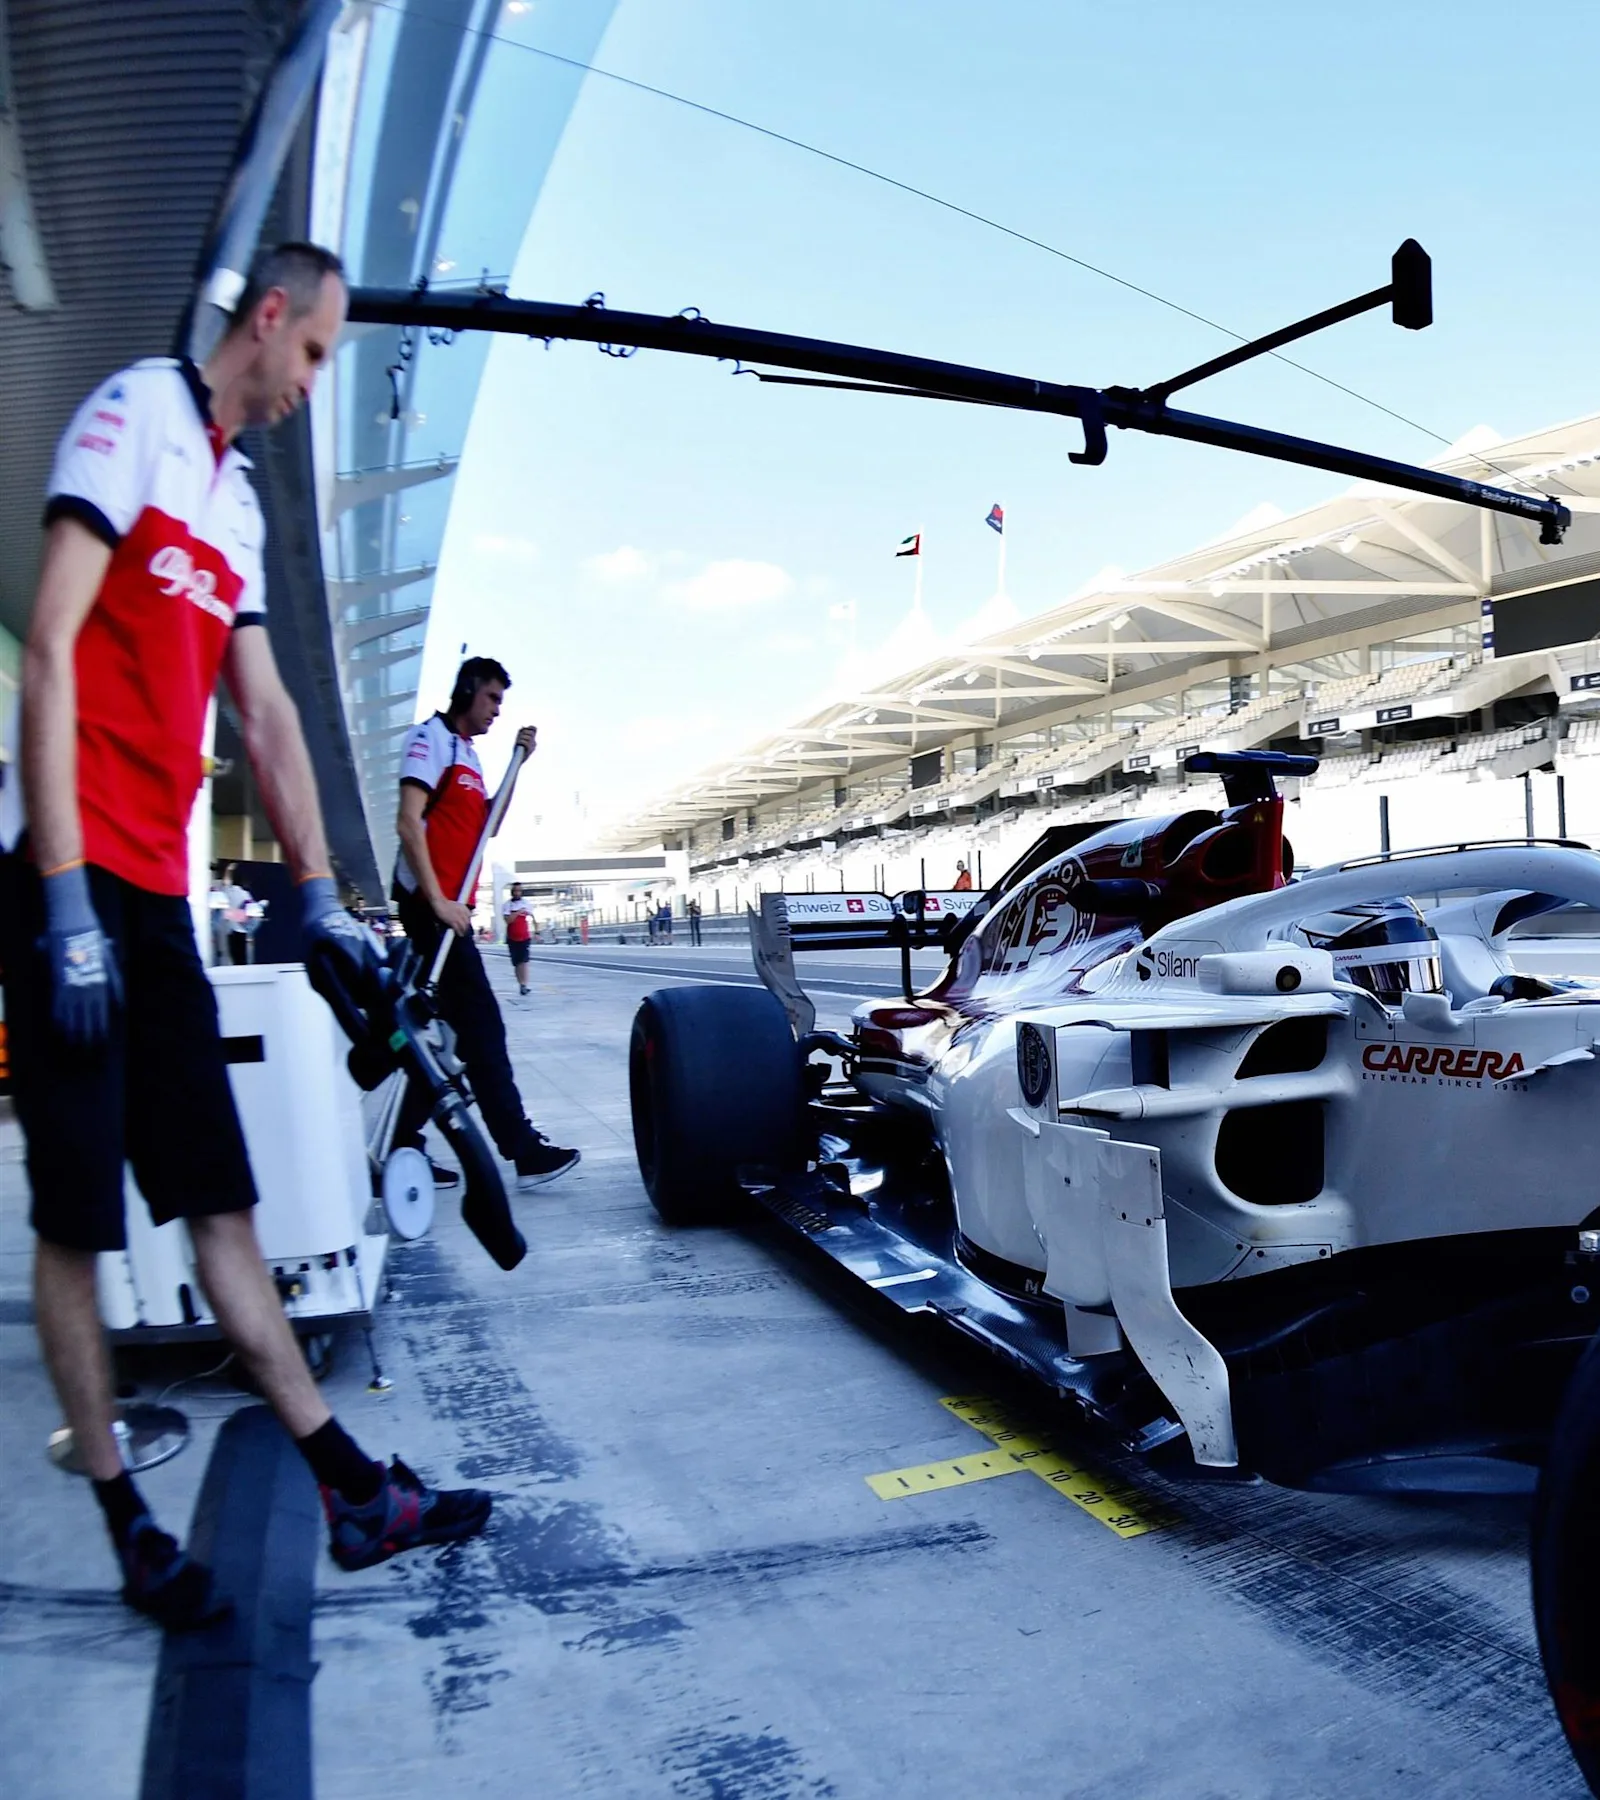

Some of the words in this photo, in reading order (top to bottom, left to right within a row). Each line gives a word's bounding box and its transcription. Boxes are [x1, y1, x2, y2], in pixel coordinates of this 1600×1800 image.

[787, 901, 843, 914] chweiz
[1362, 1044, 1527, 1081] CARRERA
[1362, 1072, 1427, 1085] EYEWEAR
[1438, 1078, 1482, 1089] SINCE
[969, 1415, 990, 1425] 20
[993, 1430, 1017, 1442] 10
[1020, 1451, 1039, 1459] 0
[1046, 1469, 1072, 1483] 10
[1074, 1491, 1105, 1505] 20
[1108, 1514, 1139, 1529] 30
